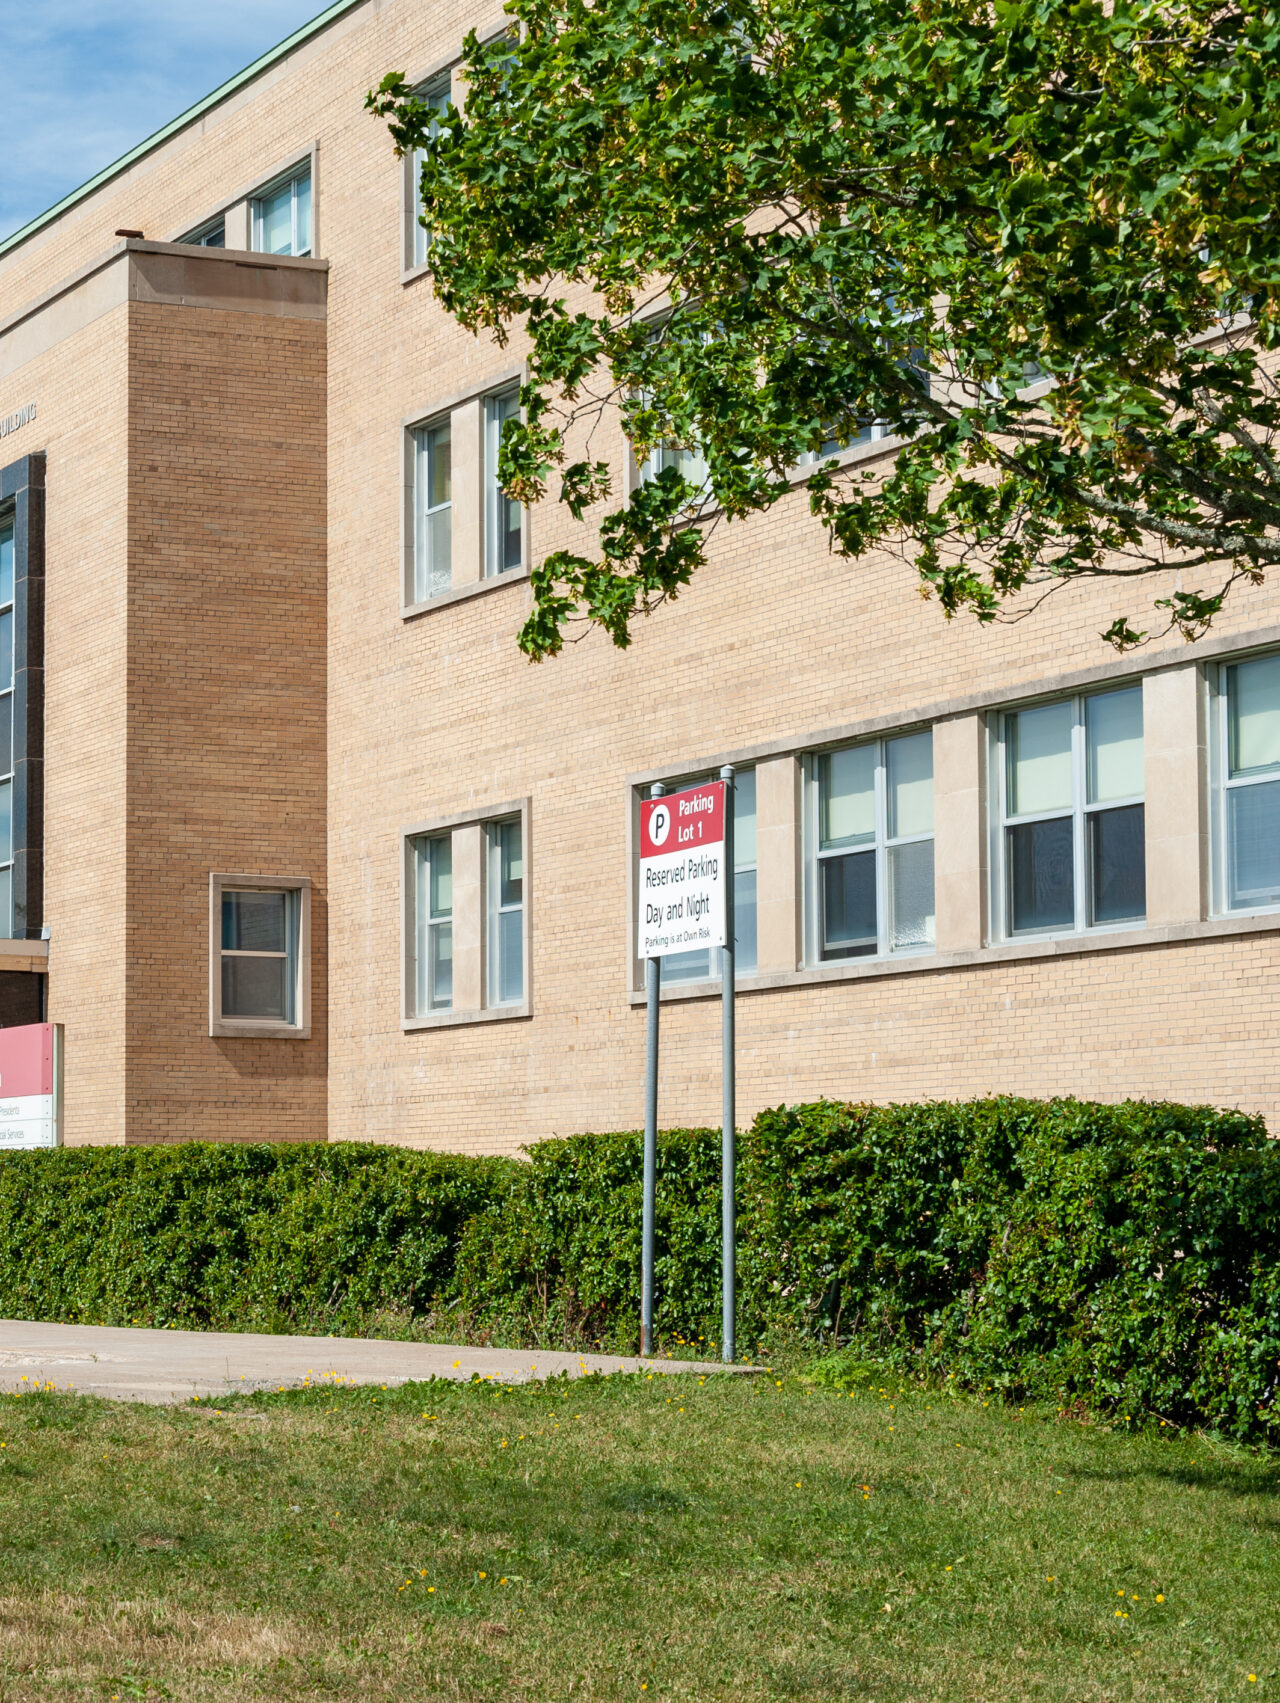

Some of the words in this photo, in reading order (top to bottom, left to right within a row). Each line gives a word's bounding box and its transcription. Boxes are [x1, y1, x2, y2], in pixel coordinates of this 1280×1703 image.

[679, 794, 714, 817] Parking
[655, 813, 665, 839] P
[678, 825, 694, 843] Lot
[697, 820, 703, 838] 1
[646, 859, 685, 889] Reserved
[688, 854, 718, 881] Parking
[646, 903, 664, 928] Day
[667, 896, 683, 921] and
[686, 892, 710, 921] Night
[645, 936, 669, 948] Parking
[670, 933, 675, 944] is
[676, 932, 683, 943] at
[683, 929, 697, 942] Own
[698, 927, 711, 939] Risk
